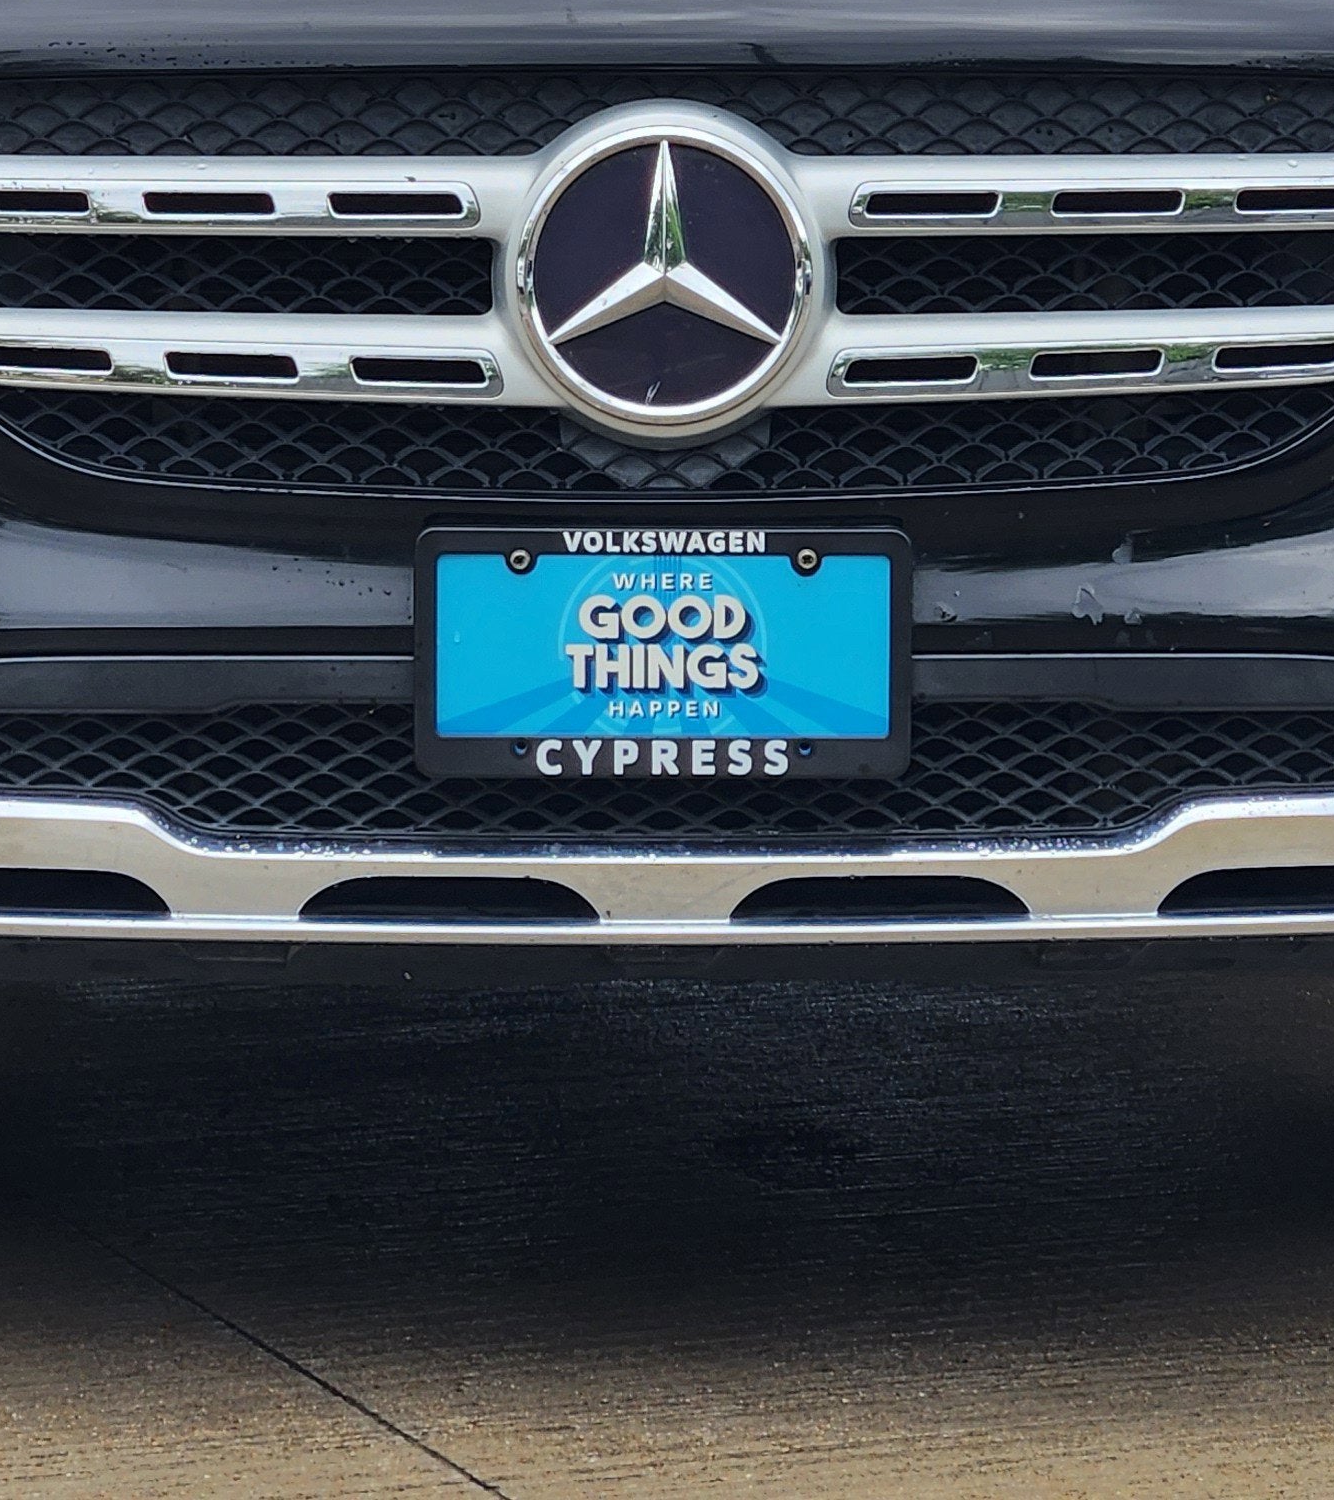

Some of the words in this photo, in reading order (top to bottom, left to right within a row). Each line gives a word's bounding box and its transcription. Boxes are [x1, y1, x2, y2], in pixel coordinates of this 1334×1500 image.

[563, 531, 765, 553] VOLKSWAGEN
[613, 573, 713, 590] WHERE
[579, 594, 746, 639] GOOD
[565, 643, 759, 689] THINGS
[609, 701, 720, 718] HAPPEN
[535, 739, 789, 776] CYPRESS
